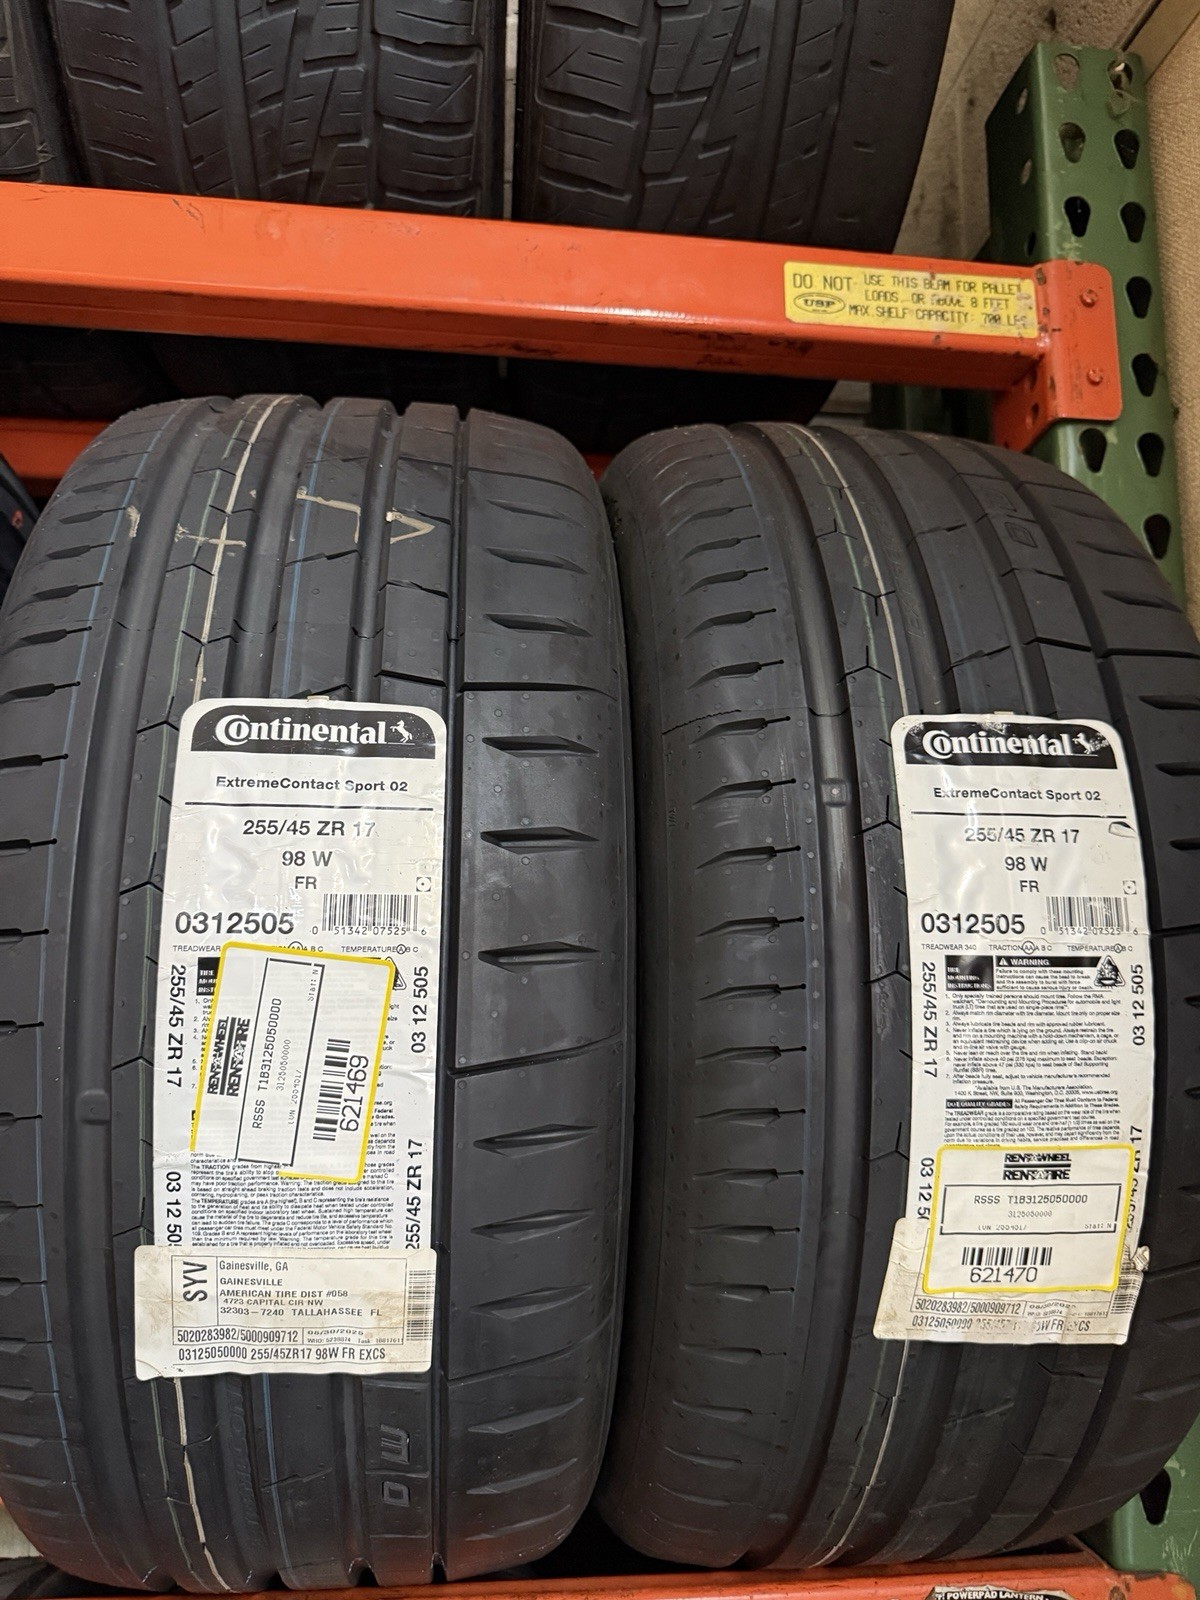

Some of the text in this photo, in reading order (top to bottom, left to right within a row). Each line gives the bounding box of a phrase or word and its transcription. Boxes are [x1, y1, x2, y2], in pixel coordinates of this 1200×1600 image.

[793, 274, 1020, 295] DO NOT USE THIS BEAM FOR PALLET
[912, 293, 924, 304] OR
[931, 294, 964, 308] ABOVE
[970, 297, 978, 308] 8
[984, 298, 1009, 310] FEET
[876, 306, 908, 318] SHELF
[215, 714, 386, 746] Continental
[922, 730, 1072, 759] Continental
[216, 776, 408, 794] ExtremeContact Sport 02
[934, 788, 1101, 802] ExtremeContact Sport 02
[243, 820, 376, 837] 255/45 ZR 17
[965, 828, 1079, 843] 255/45 ZR 17
[282, 851, 332, 866] 98 W
[1004, 857, 1048, 871] 98 W
[294, 876, 317, 890] FR
[1020, 880, 1040, 893] FR
[176, 912, 294, 934] 0312505
[312, 926, 427, 936] 0 51342 07525 6
[921, 913, 1025, 934] 0312505
[412, 966, 428, 1054] 03 12 505
[1130, 964, 1145, 1046] 03 12 505
[166, 964, 186, 1088] 255/45 ZR 17
[922, 962, 938, 1078] 255/45 ZR 17
[252, 998, 282, 1129] RSSS T1B3125050000
[340, 1055, 369, 1132] 621469
[1130, 1126, 1142, 1143] 17
[920, 1158, 934, 1177] 03
[405, 1138, 422, 1249] 255/45 ZR 17
[919, 1183, 932, 1201] 12
[974, 1196, 1000, 1204] RSSS
[166, 1172, 182, 1246] 03 12 50
[220, 1261, 288, 1272] Gainesville, GA
[970, 1267, 1038, 1283] 621470
[182, 1260, 208, 1302] SYV
[220, 1278, 282, 1286] GAINESVILLE
[220, 1290, 348, 1298] AMERICAN TIRE DIST #058
[292, 1308, 363, 1316] TALLAHASSEE
[915, 1302, 1021, 1314] 5020283982/5000909712
[1051, 1318, 1063, 1330] FR
[177, 1328, 298, 1342] 5020283982/5000909712
[178, 1346, 386, 1361] 03125050000 255/45ZR17 98W FR EXCS
[947, 1591, 997, 1600] POWERPAD
[1000, 1591, 1044, 1600] LANTERN
